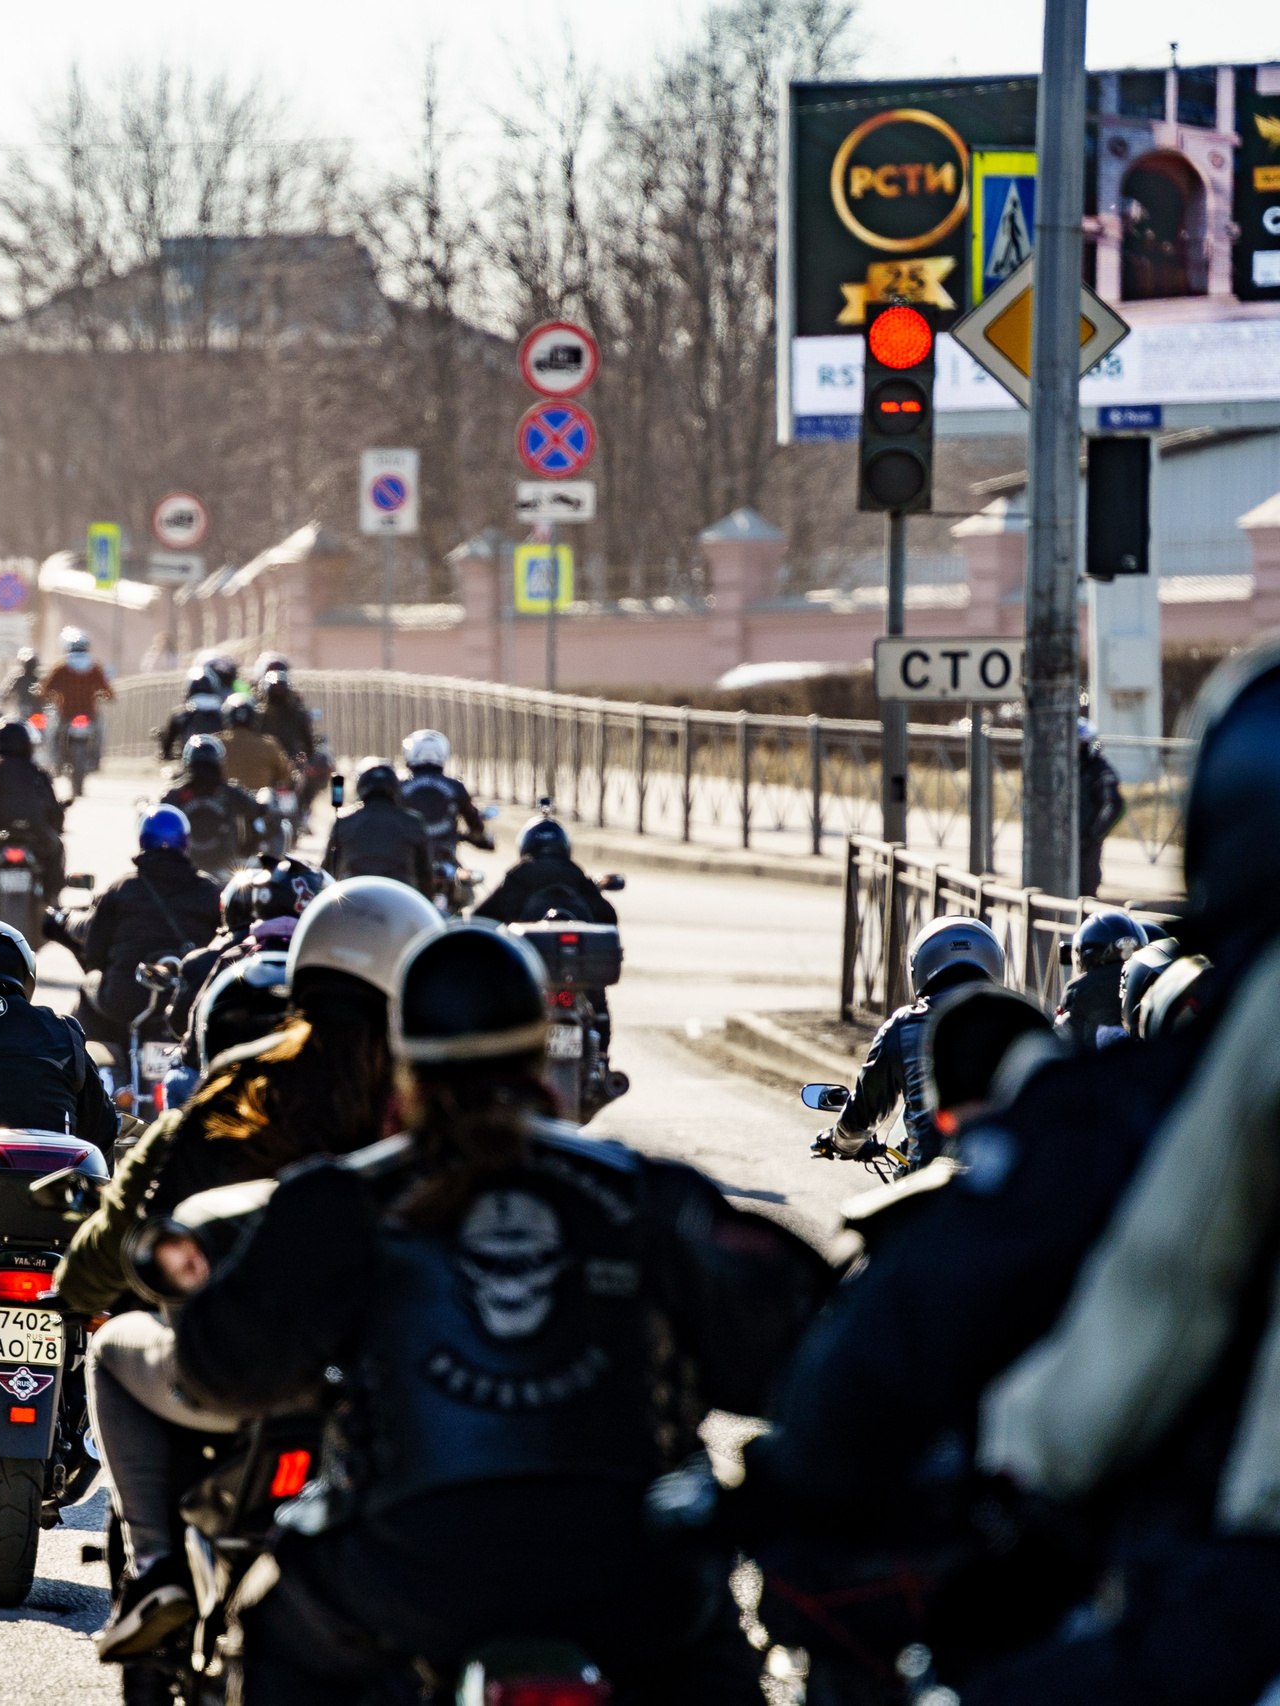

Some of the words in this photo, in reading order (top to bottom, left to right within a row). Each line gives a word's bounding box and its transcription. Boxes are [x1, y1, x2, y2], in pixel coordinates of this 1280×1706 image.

[850, 162, 956, 199] РСТИ
[900, 650, 1012, 689] СТО
[0, 1310, 51, 1332] 7402
[26, 1333, 43, 1341] RUS
[32, 1341, 58, 1360] 78
